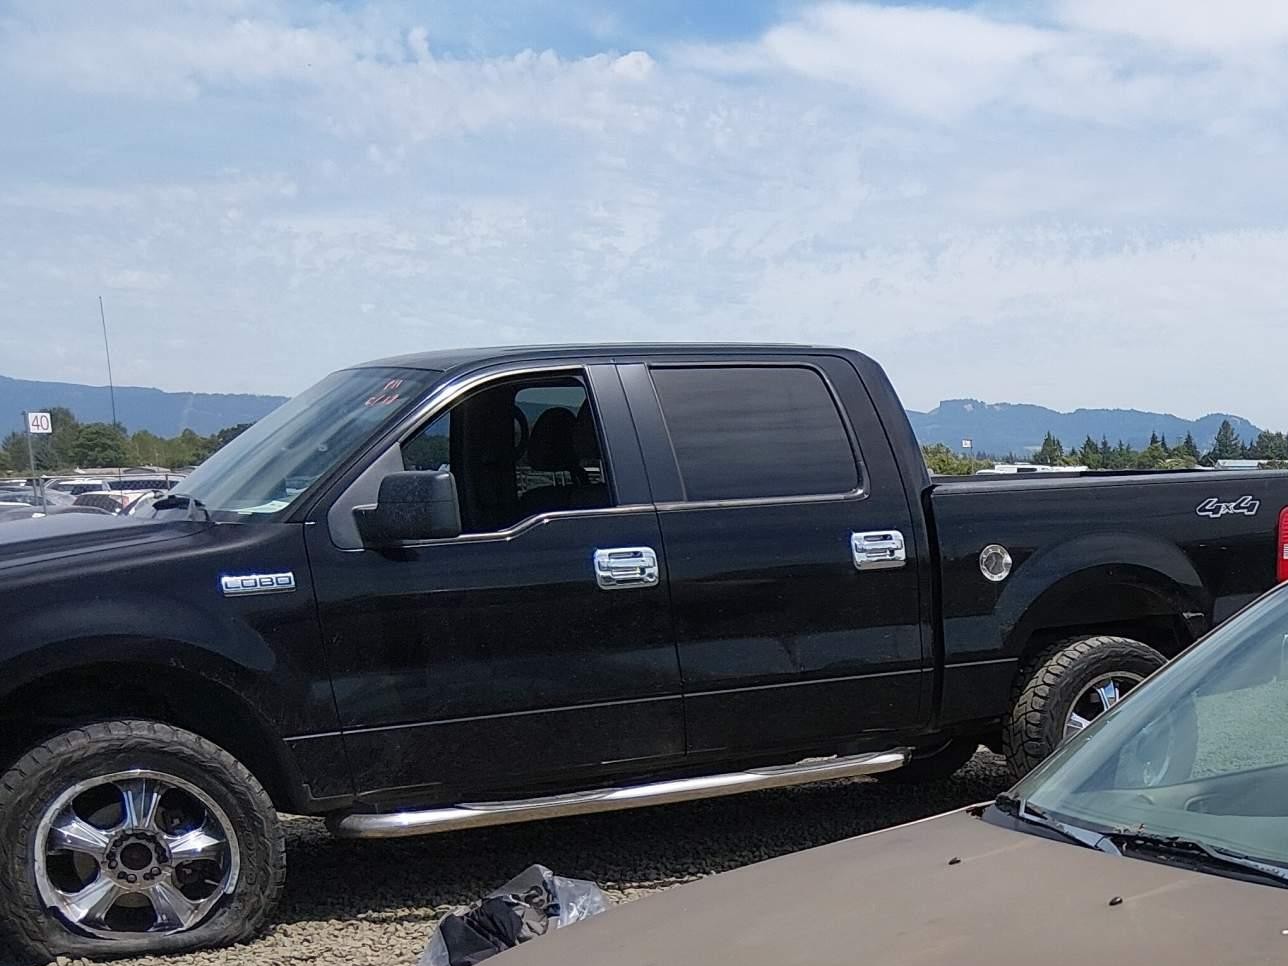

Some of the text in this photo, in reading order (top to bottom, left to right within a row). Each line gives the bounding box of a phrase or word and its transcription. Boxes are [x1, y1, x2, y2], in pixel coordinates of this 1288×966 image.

[31, 415, 50, 431] 40
[1196, 496, 1260, 518] 4x4
[224, 576, 293, 590] LOBO
